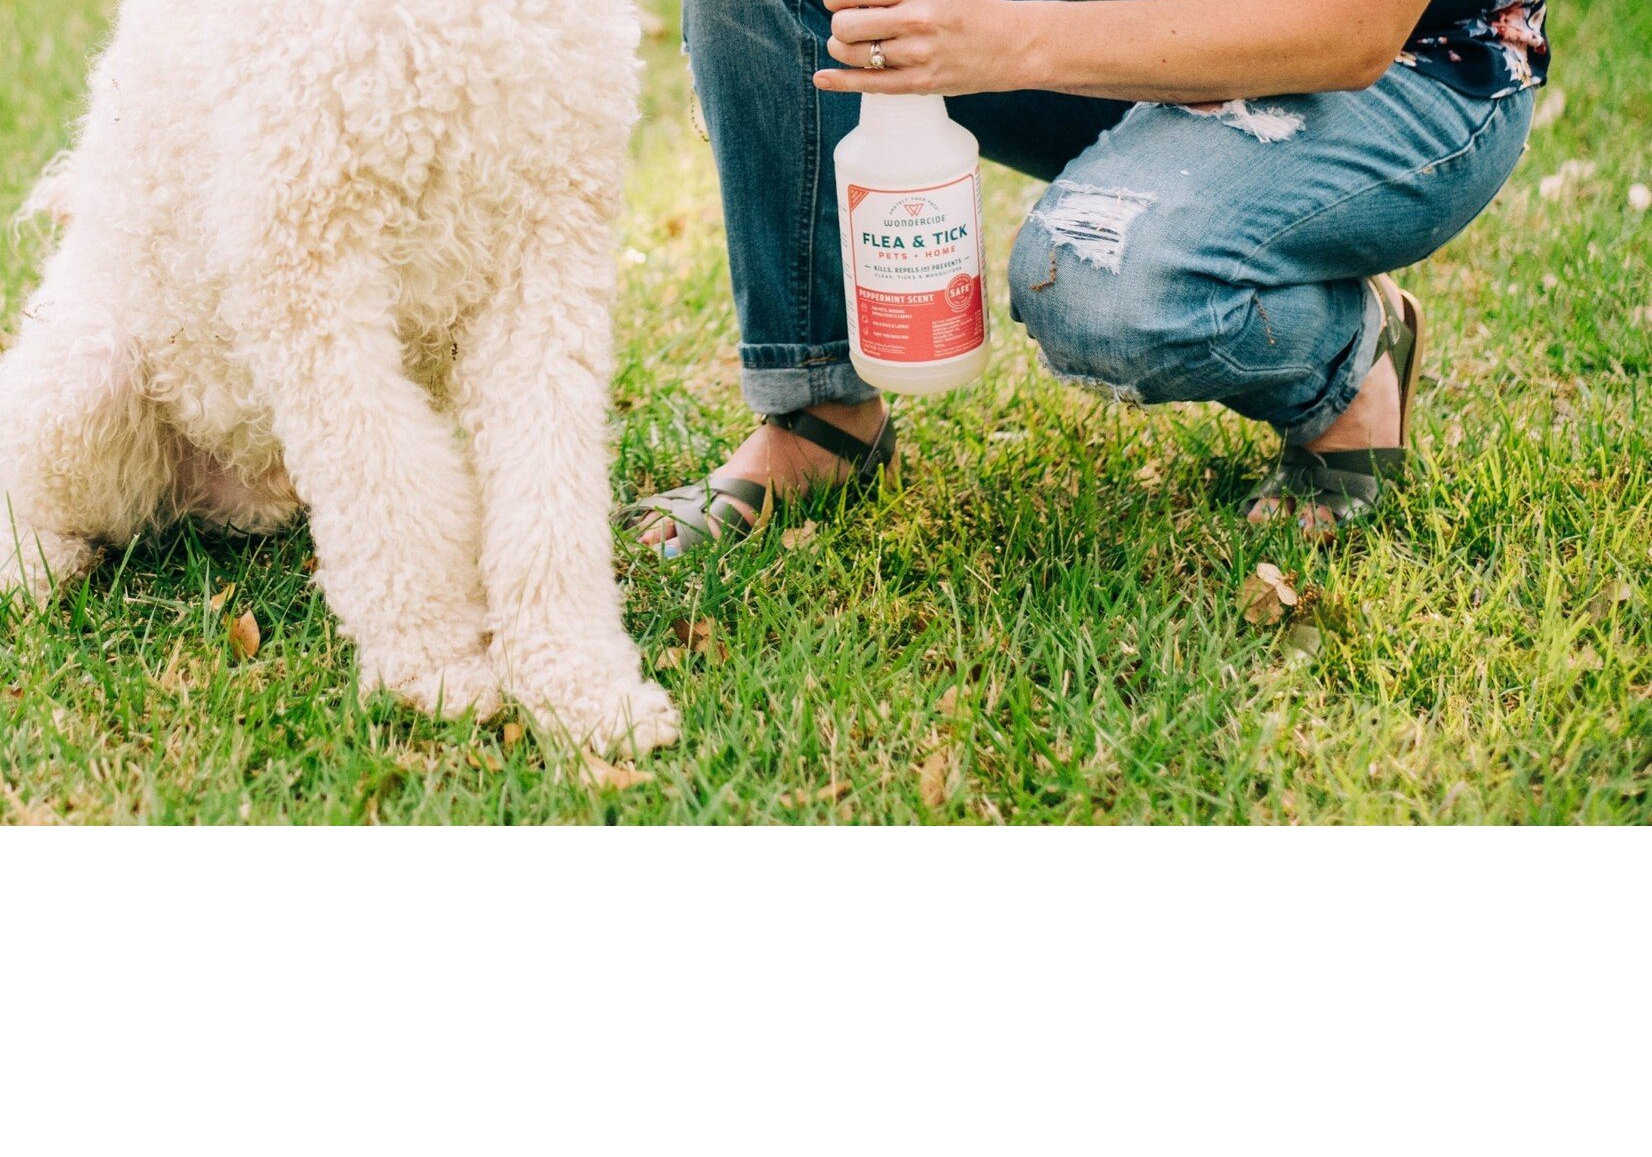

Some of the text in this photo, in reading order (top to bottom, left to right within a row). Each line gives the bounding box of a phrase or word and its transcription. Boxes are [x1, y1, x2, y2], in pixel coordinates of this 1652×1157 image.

[884, 215, 946, 226] WONDERCIDE
[862, 224, 968, 250] FLEA & TICK
[878, 252, 908, 260] PETS
[925, 245, 956, 258] HOME
[894, 265, 919, 274] REPELS
[932, 258, 962, 270] PREVENTS
[858, 290, 935, 304] PEPPERMINT SCENT
[949, 284, 970, 298] SAFE
